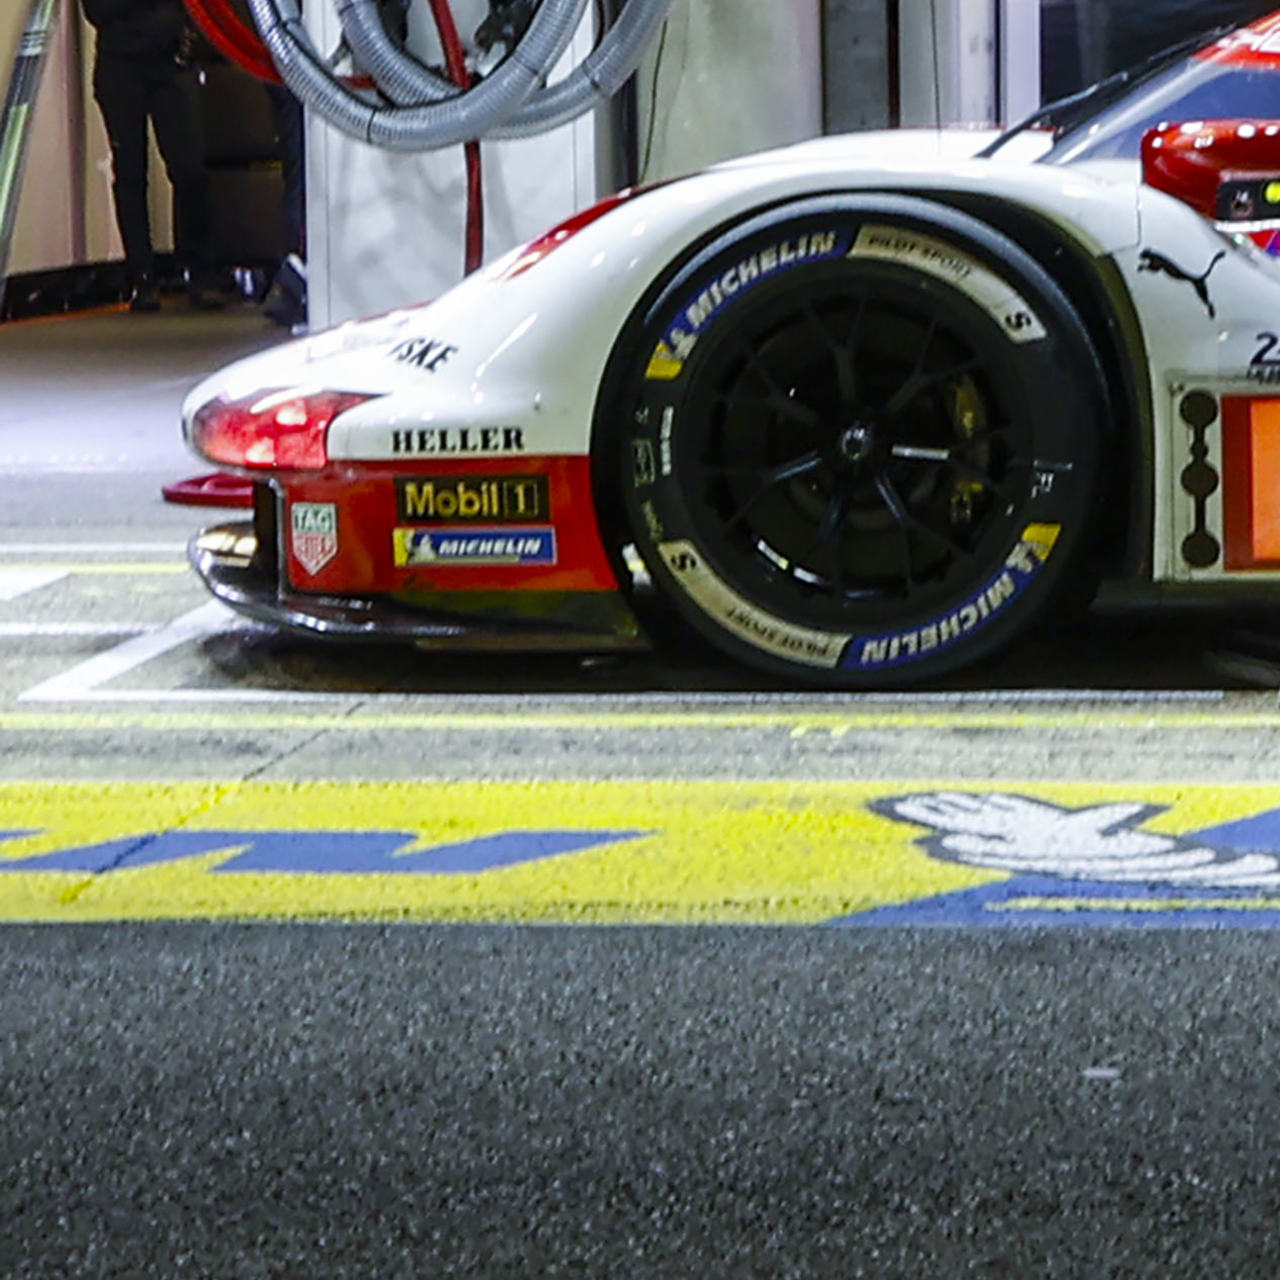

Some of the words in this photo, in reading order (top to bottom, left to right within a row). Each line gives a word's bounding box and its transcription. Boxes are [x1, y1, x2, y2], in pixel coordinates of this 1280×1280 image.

[685, 230, 838, 328] MICHELIN
[392, 426, 526, 454] HELLER
[404, 481, 500, 518] Mobil
[437, 538, 543, 557] MICHELIN
[860, 572, 1016, 665] MICHELIN
